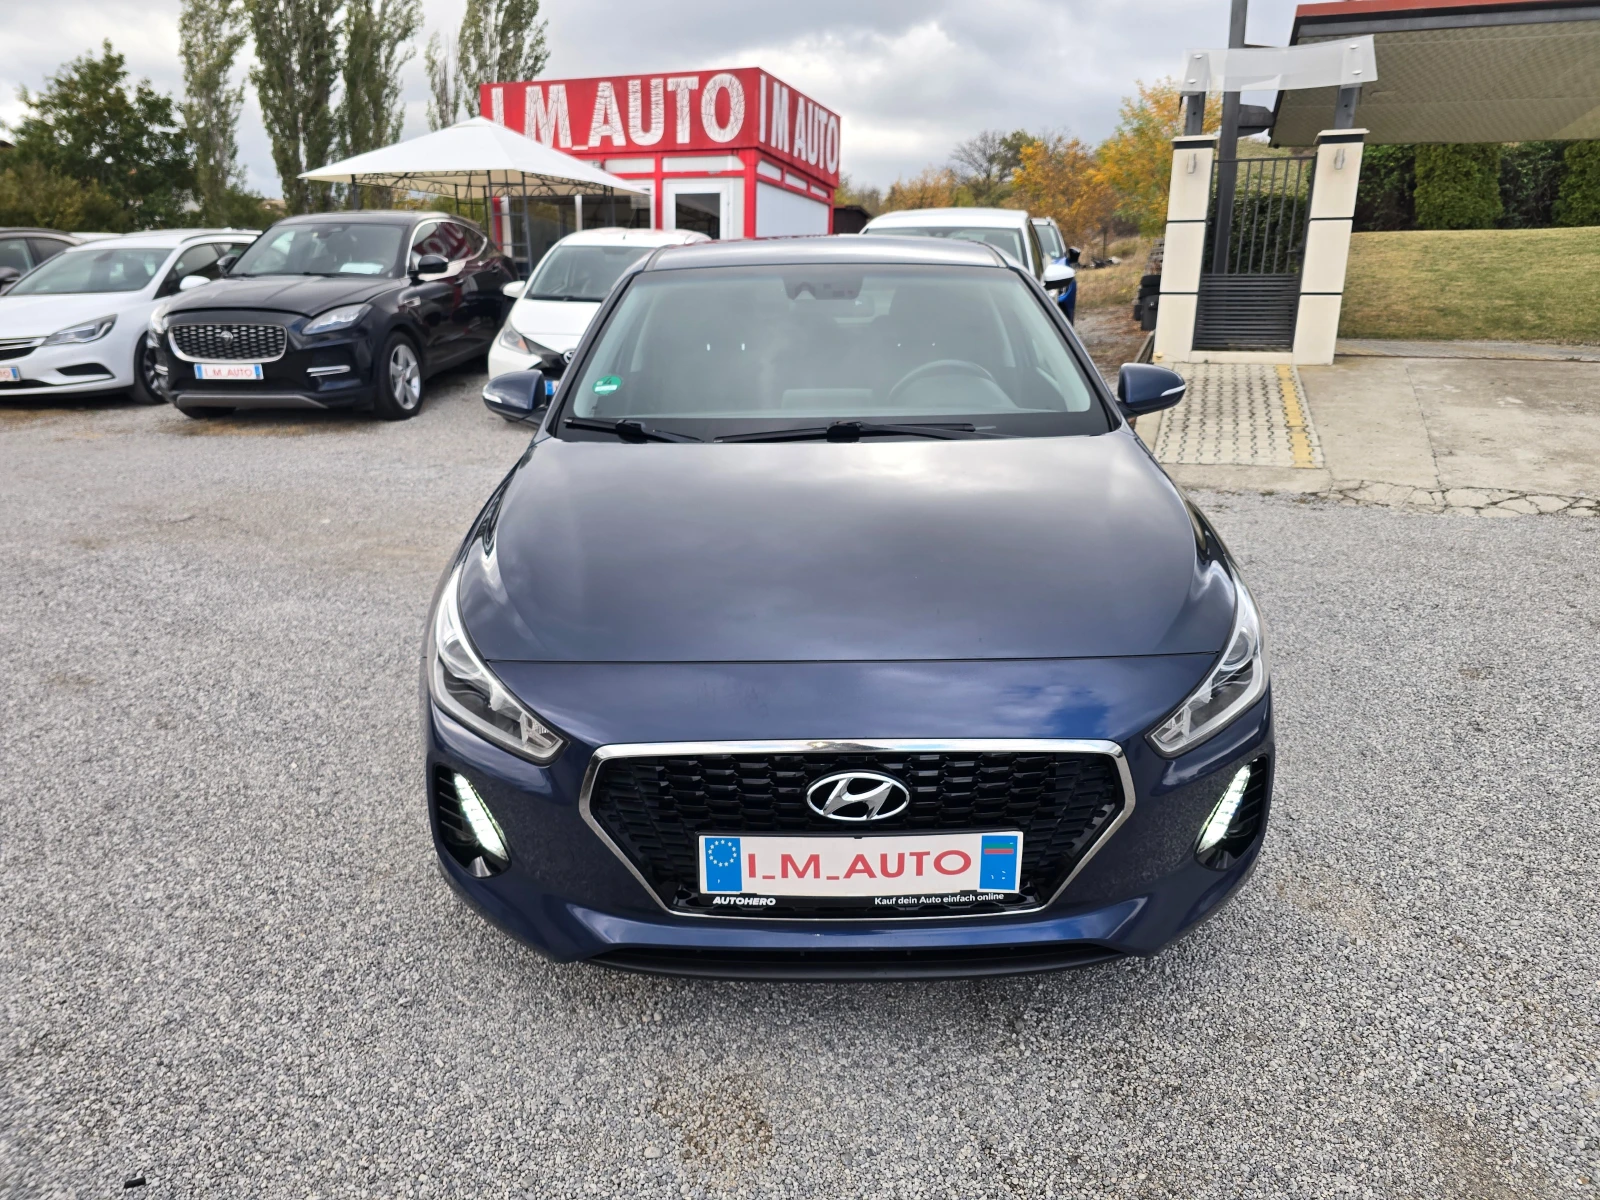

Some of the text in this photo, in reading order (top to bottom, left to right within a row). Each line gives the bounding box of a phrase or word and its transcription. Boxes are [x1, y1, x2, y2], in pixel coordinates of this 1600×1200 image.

[793, 96, 839, 175] AUTO
[748, 850, 972, 880] I_M_AUTO
[713, 896, 777, 906] AUTOHERO
[874, 892, 1004, 905] Kauf dein Auto einfach online
